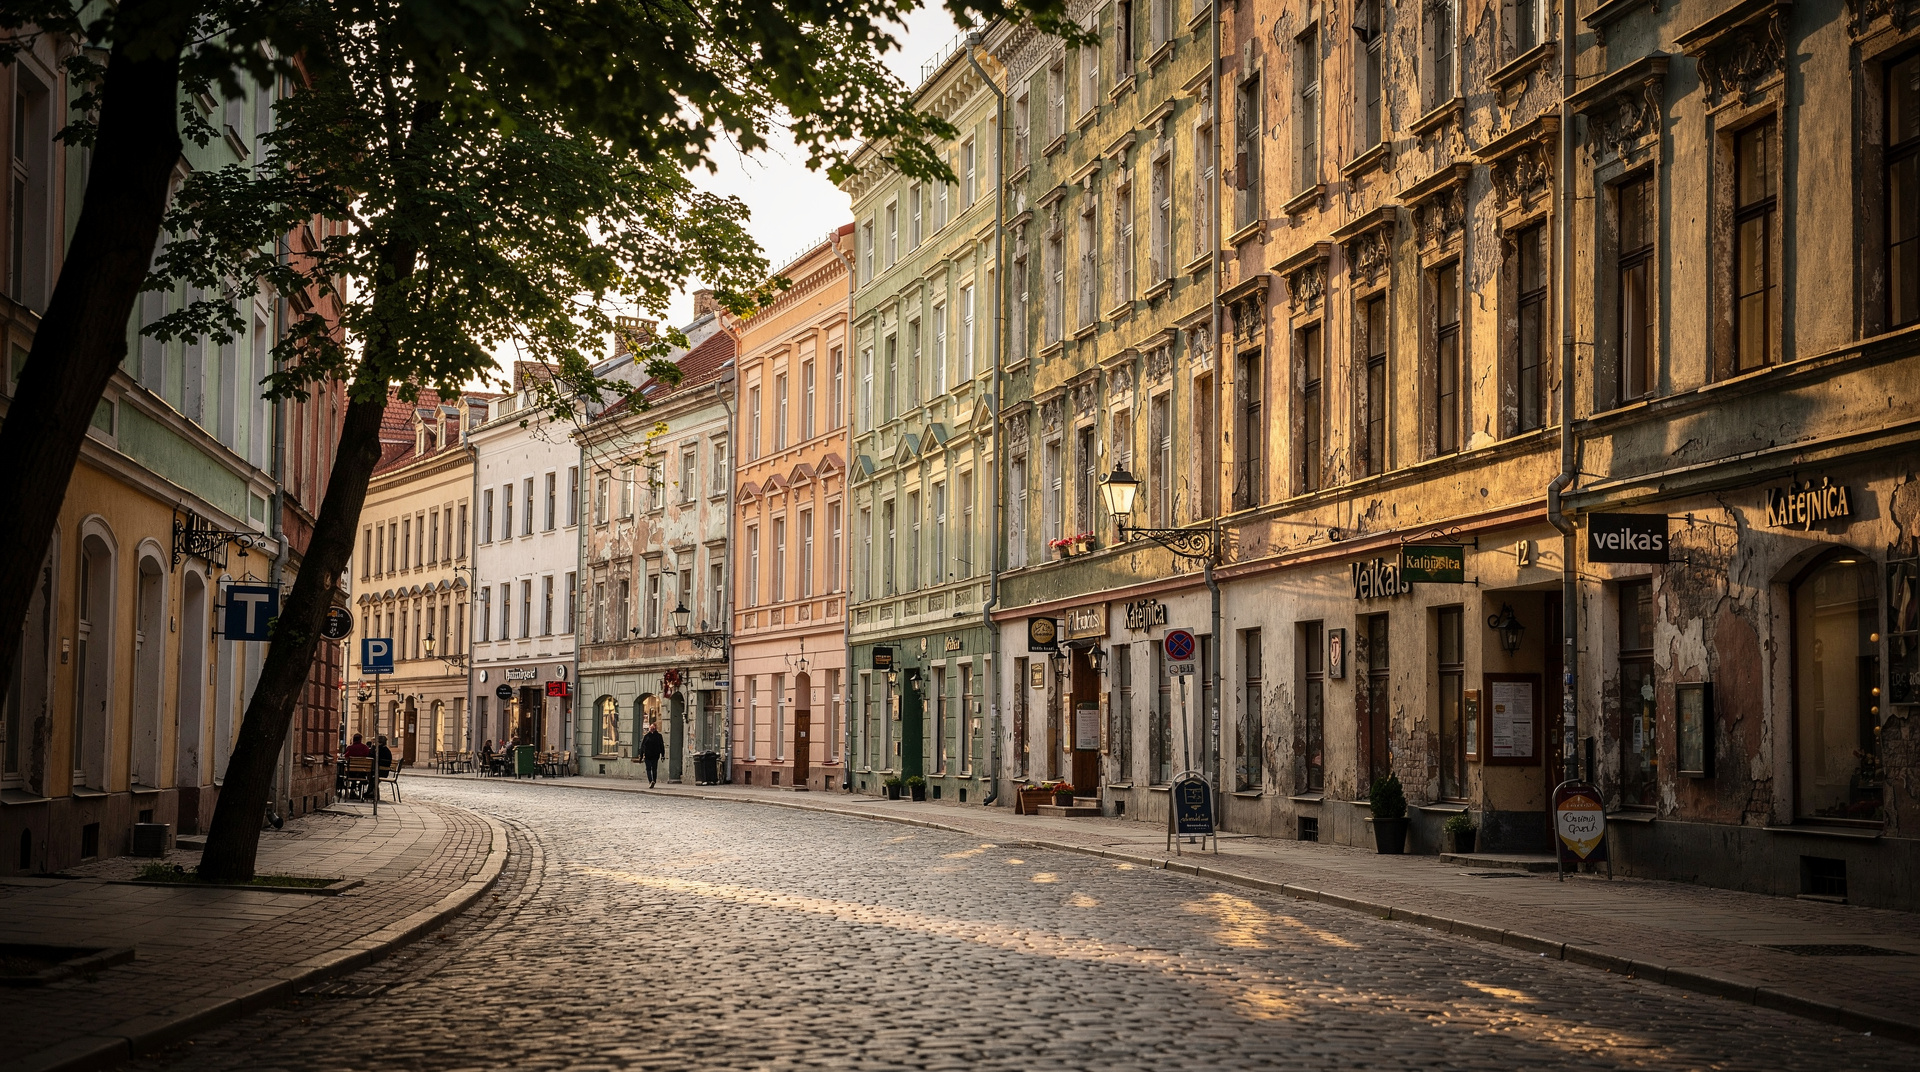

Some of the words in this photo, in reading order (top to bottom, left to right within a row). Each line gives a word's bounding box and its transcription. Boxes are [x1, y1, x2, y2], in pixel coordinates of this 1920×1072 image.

[1515, 539, 1529, 566] 12
[233, 592, 269, 634] T
[368, 640, 388, 665] P
